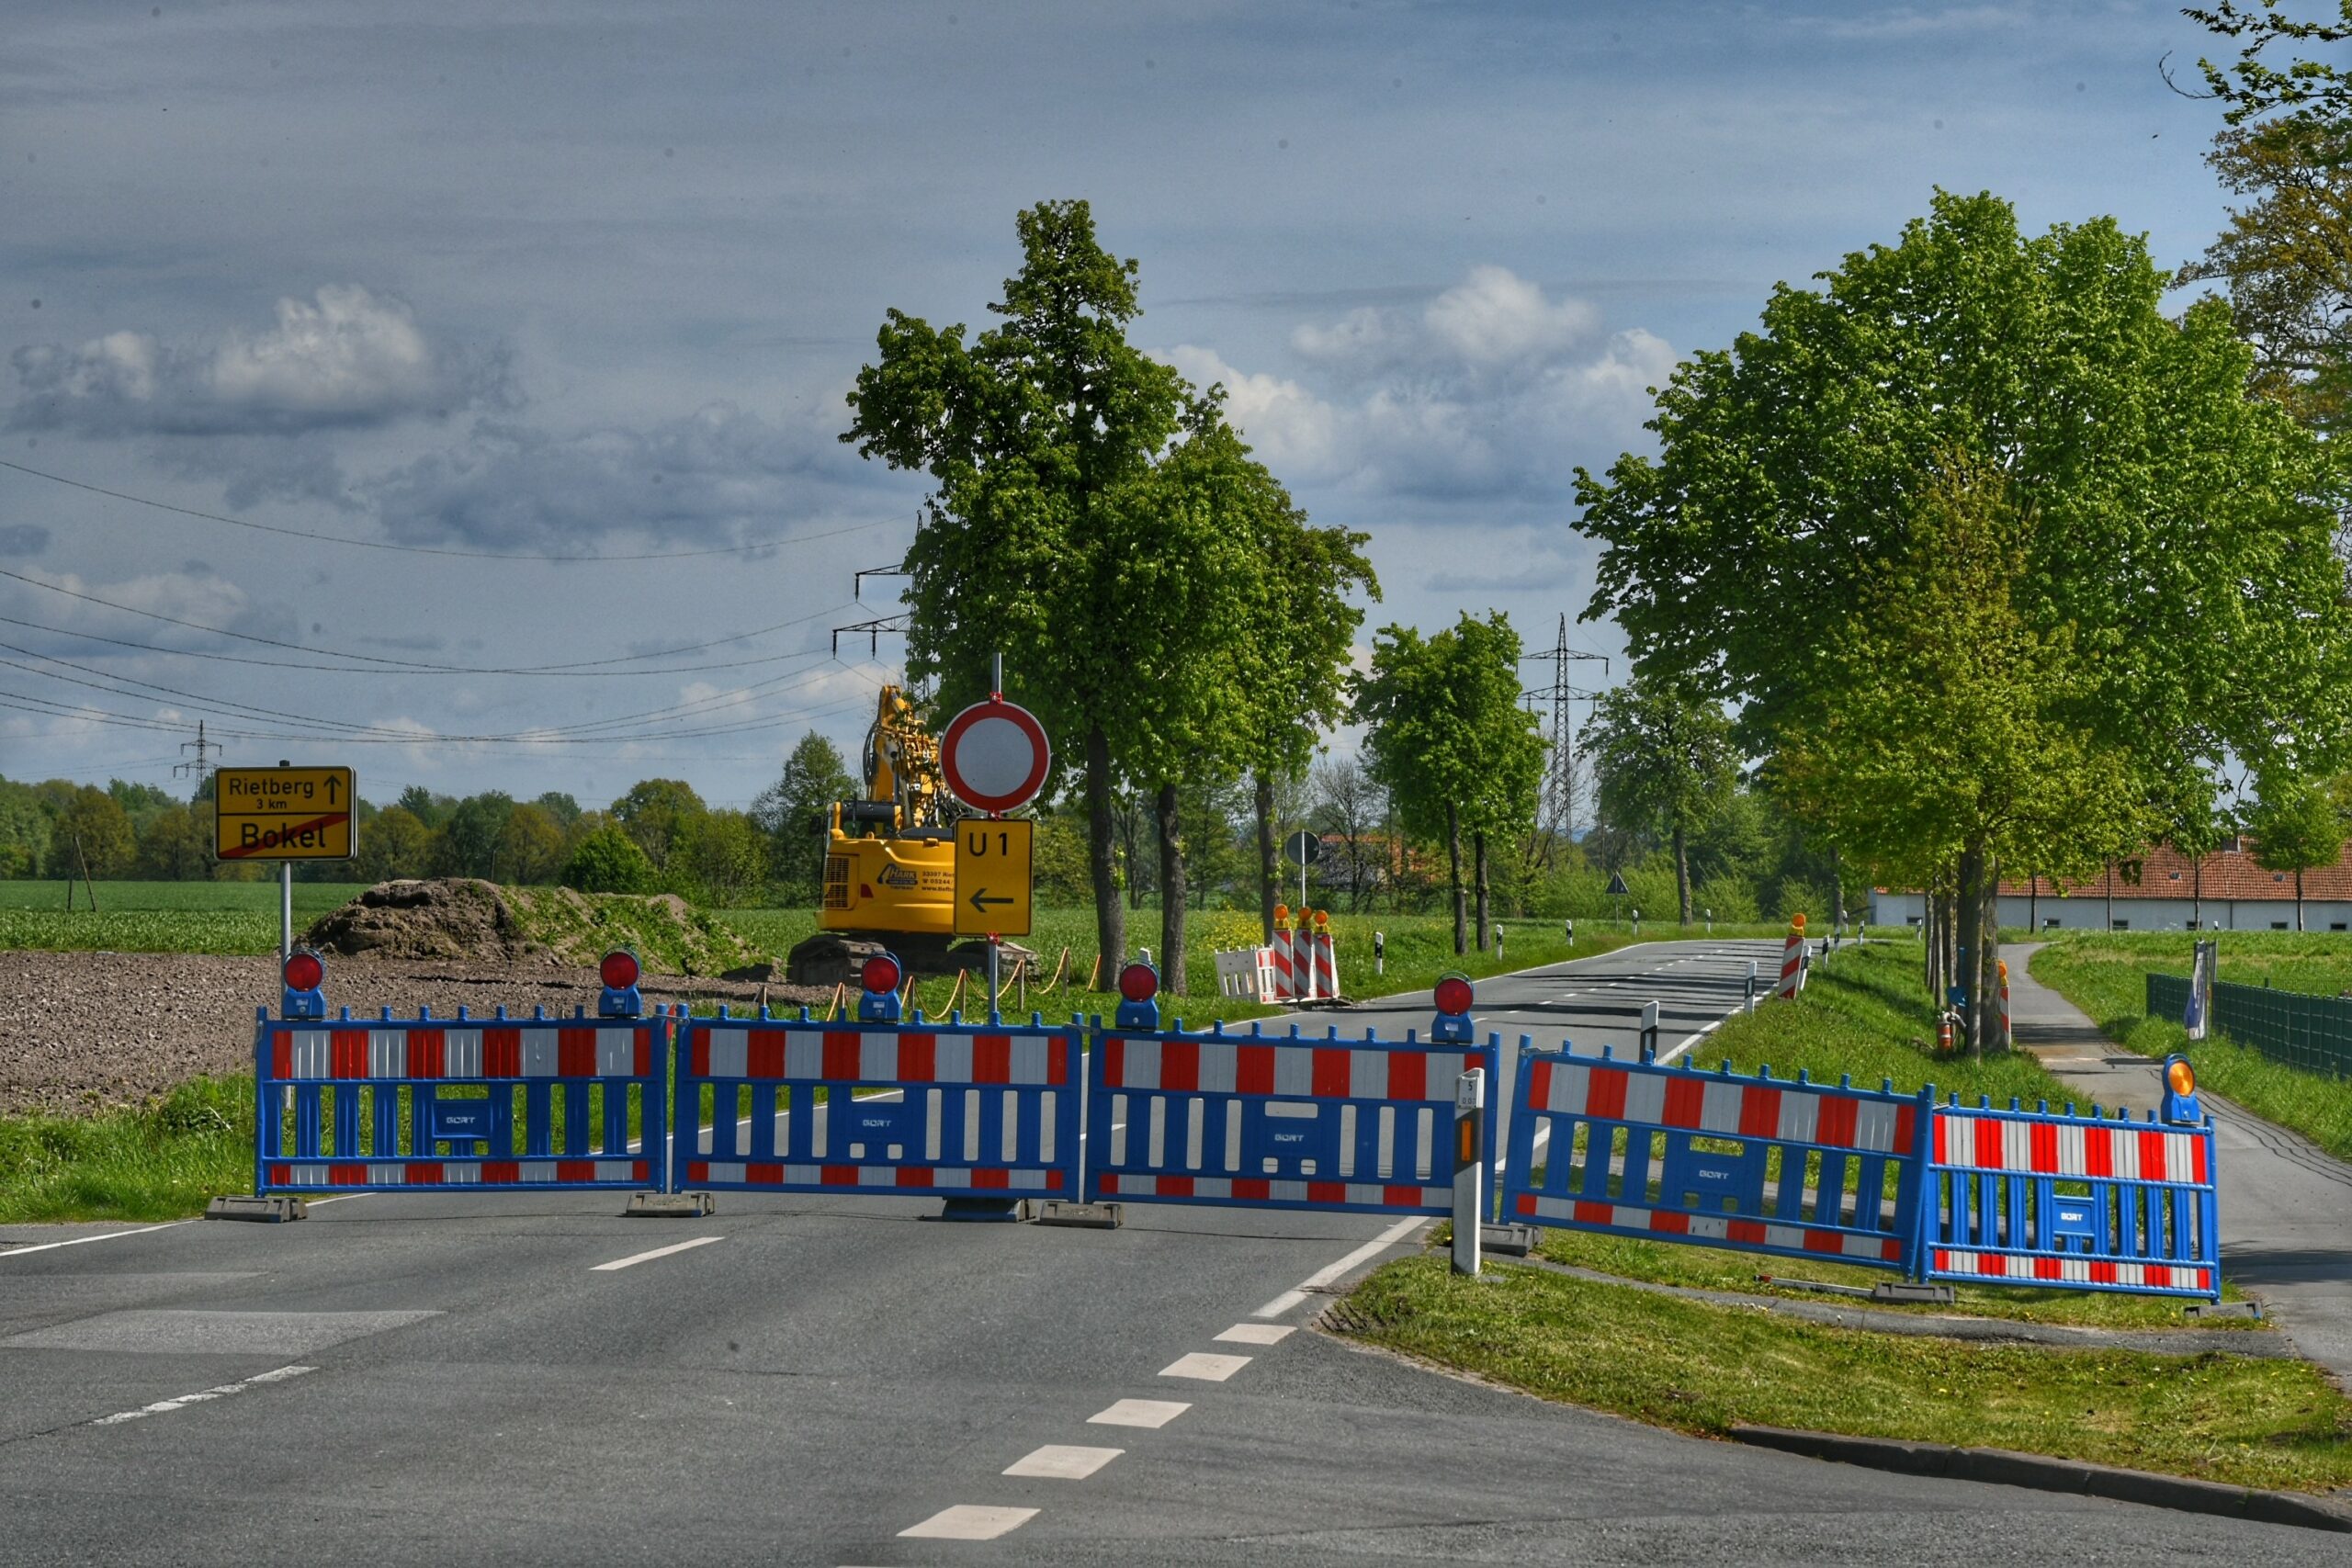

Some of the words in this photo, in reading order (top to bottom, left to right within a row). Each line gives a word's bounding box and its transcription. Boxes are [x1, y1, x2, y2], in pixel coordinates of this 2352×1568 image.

[229, 778, 314, 799] Rietberg
[256, 798, 264, 809] 3
[268, 798, 288, 809] km
[241, 822, 327, 849] Bokel
[968, 832, 987, 857] U
[999, 832, 1007, 856] 1
